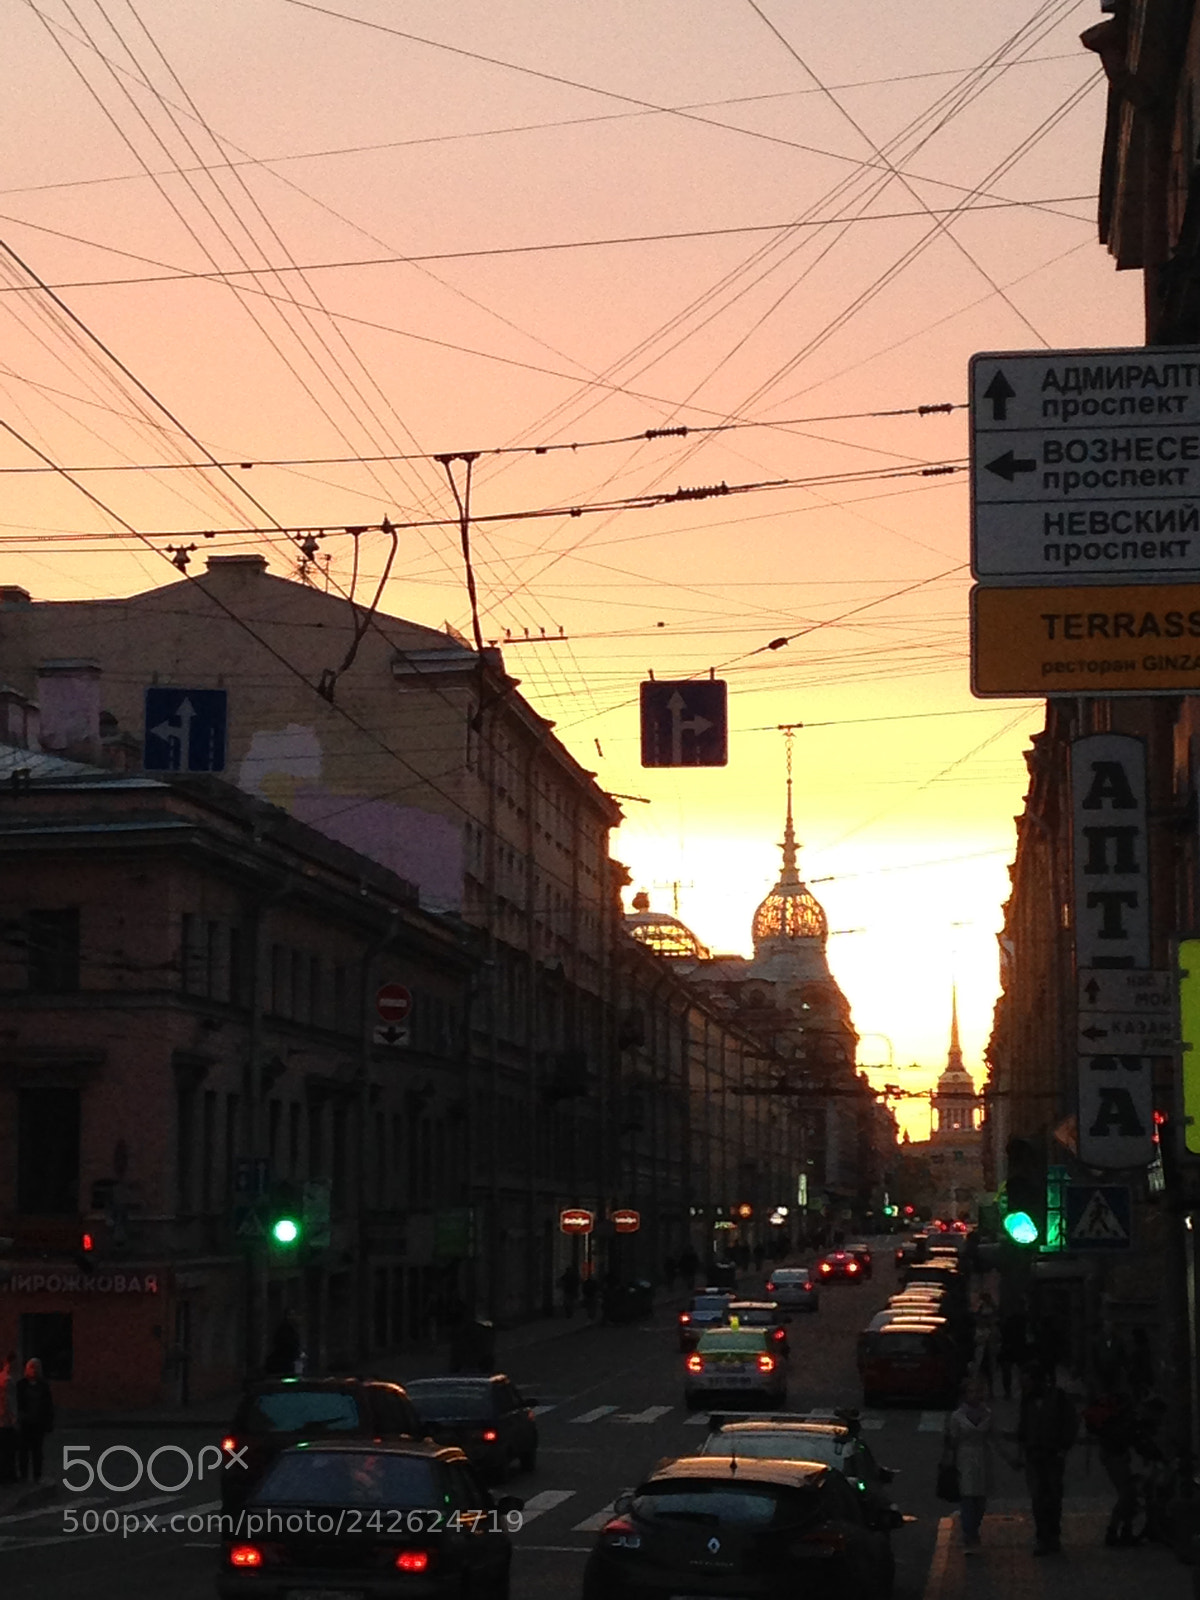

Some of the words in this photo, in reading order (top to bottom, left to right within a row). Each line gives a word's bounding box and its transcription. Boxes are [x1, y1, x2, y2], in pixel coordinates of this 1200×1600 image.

[1042, 364, 1200, 395] АДМИРАЛТ
[1042, 396, 1188, 422] проспект
[1043, 436, 1200, 464] ВОЗНЕСЕ
[1043, 468, 1190, 494] проспект
[1044, 503, 1199, 536] НЕВСКИЙ
[1044, 540, 1191, 566] проспект
[1040, 611, 1200, 639] TERRASS
[1041, 660, 1136, 677] ресторан
[1082, 761, 1146, 1137] АПТА
